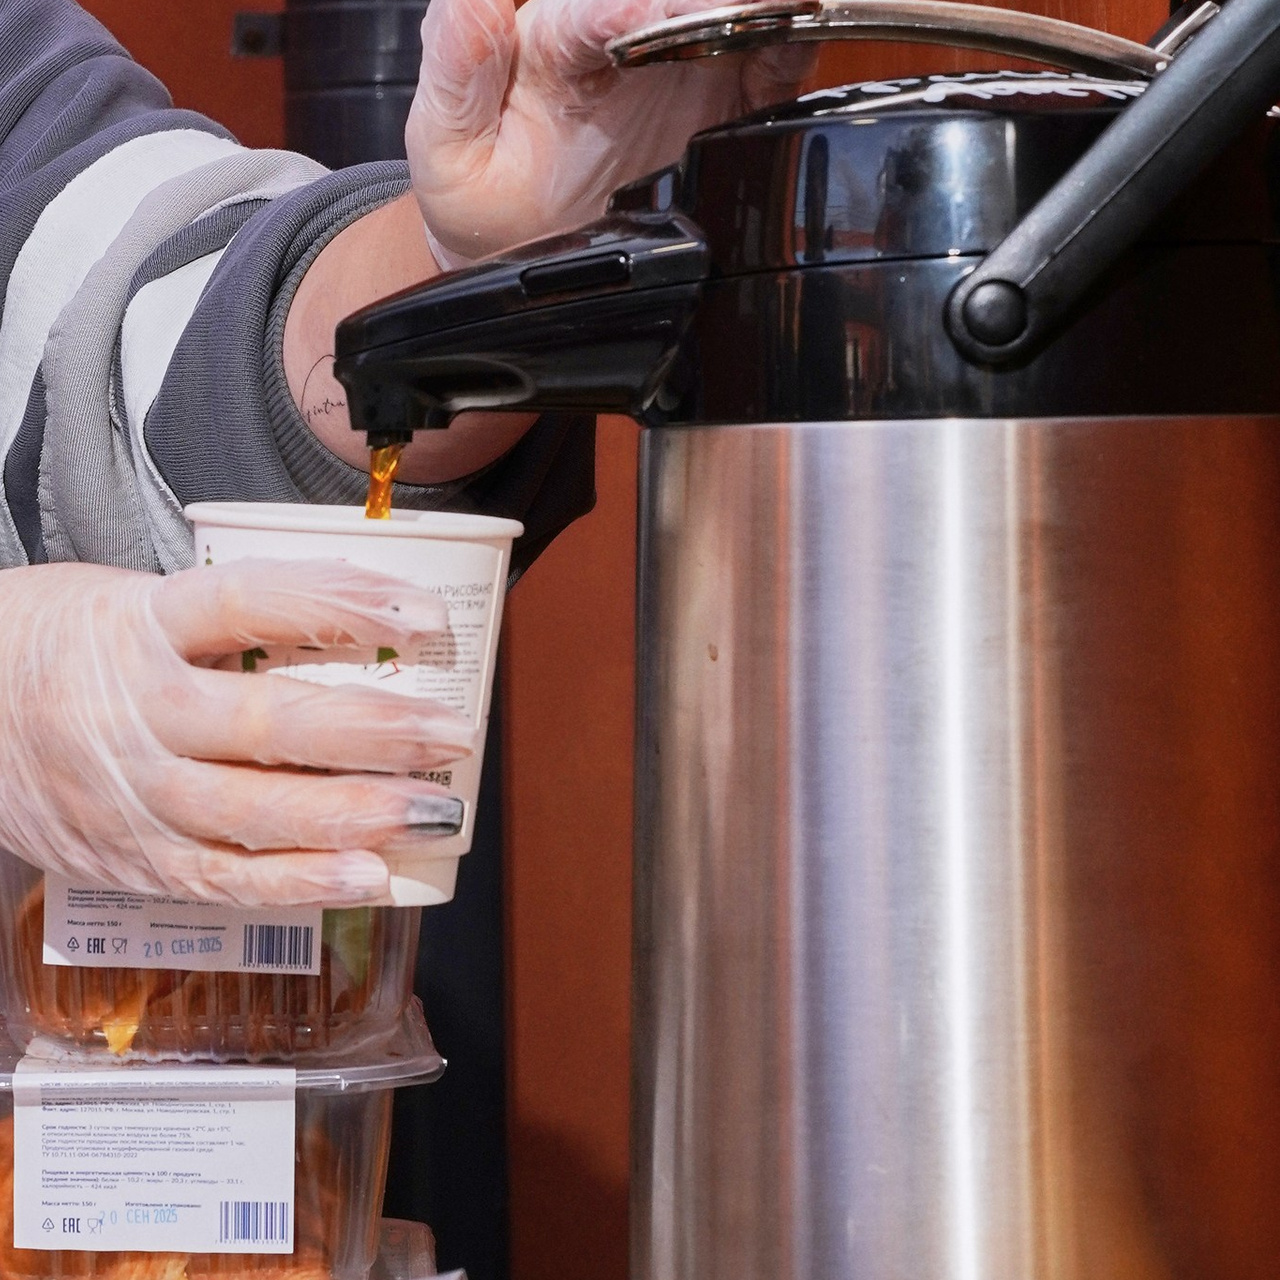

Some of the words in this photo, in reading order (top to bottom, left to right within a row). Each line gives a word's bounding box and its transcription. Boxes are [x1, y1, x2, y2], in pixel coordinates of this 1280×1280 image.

[172, 939, 194, 954] СЕН
[198, 936, 222, 954] 2025
[127, 1209, 149, 1224] СЕН
[154, 1208, 178, 1224] 2025
